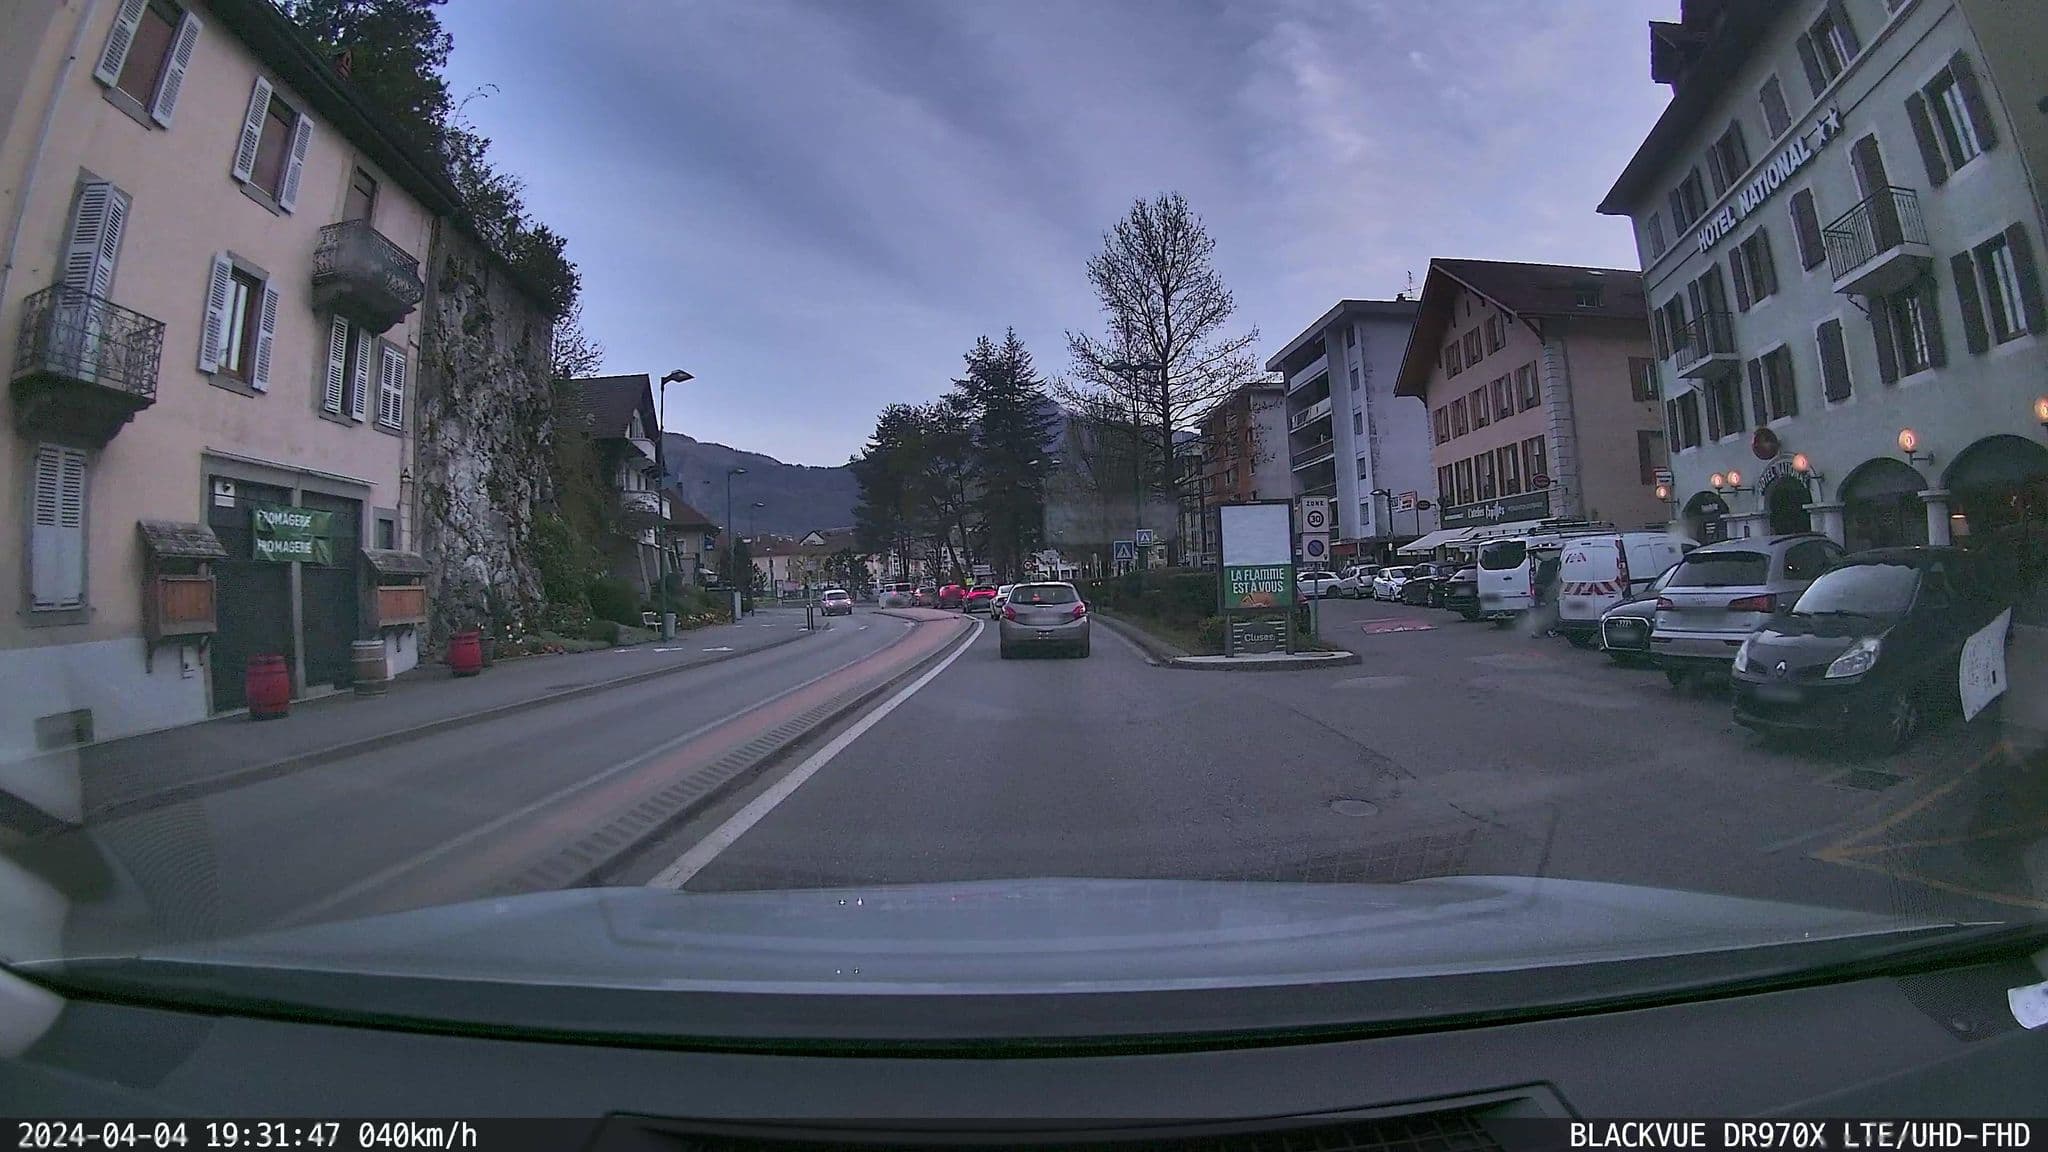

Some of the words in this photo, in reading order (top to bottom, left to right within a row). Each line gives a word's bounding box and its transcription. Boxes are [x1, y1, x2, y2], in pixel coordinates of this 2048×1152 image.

[1698, 206, 1736, 252] HOTEL
[1738, 136, 1812, 216] NATIONAL
[1310, 515, 1321, 523] 30
[1231, 569, 1243, 581] LA
[1232, 582, 1250, 594] EST
[1258, 580, 1284, 592] VOUS
